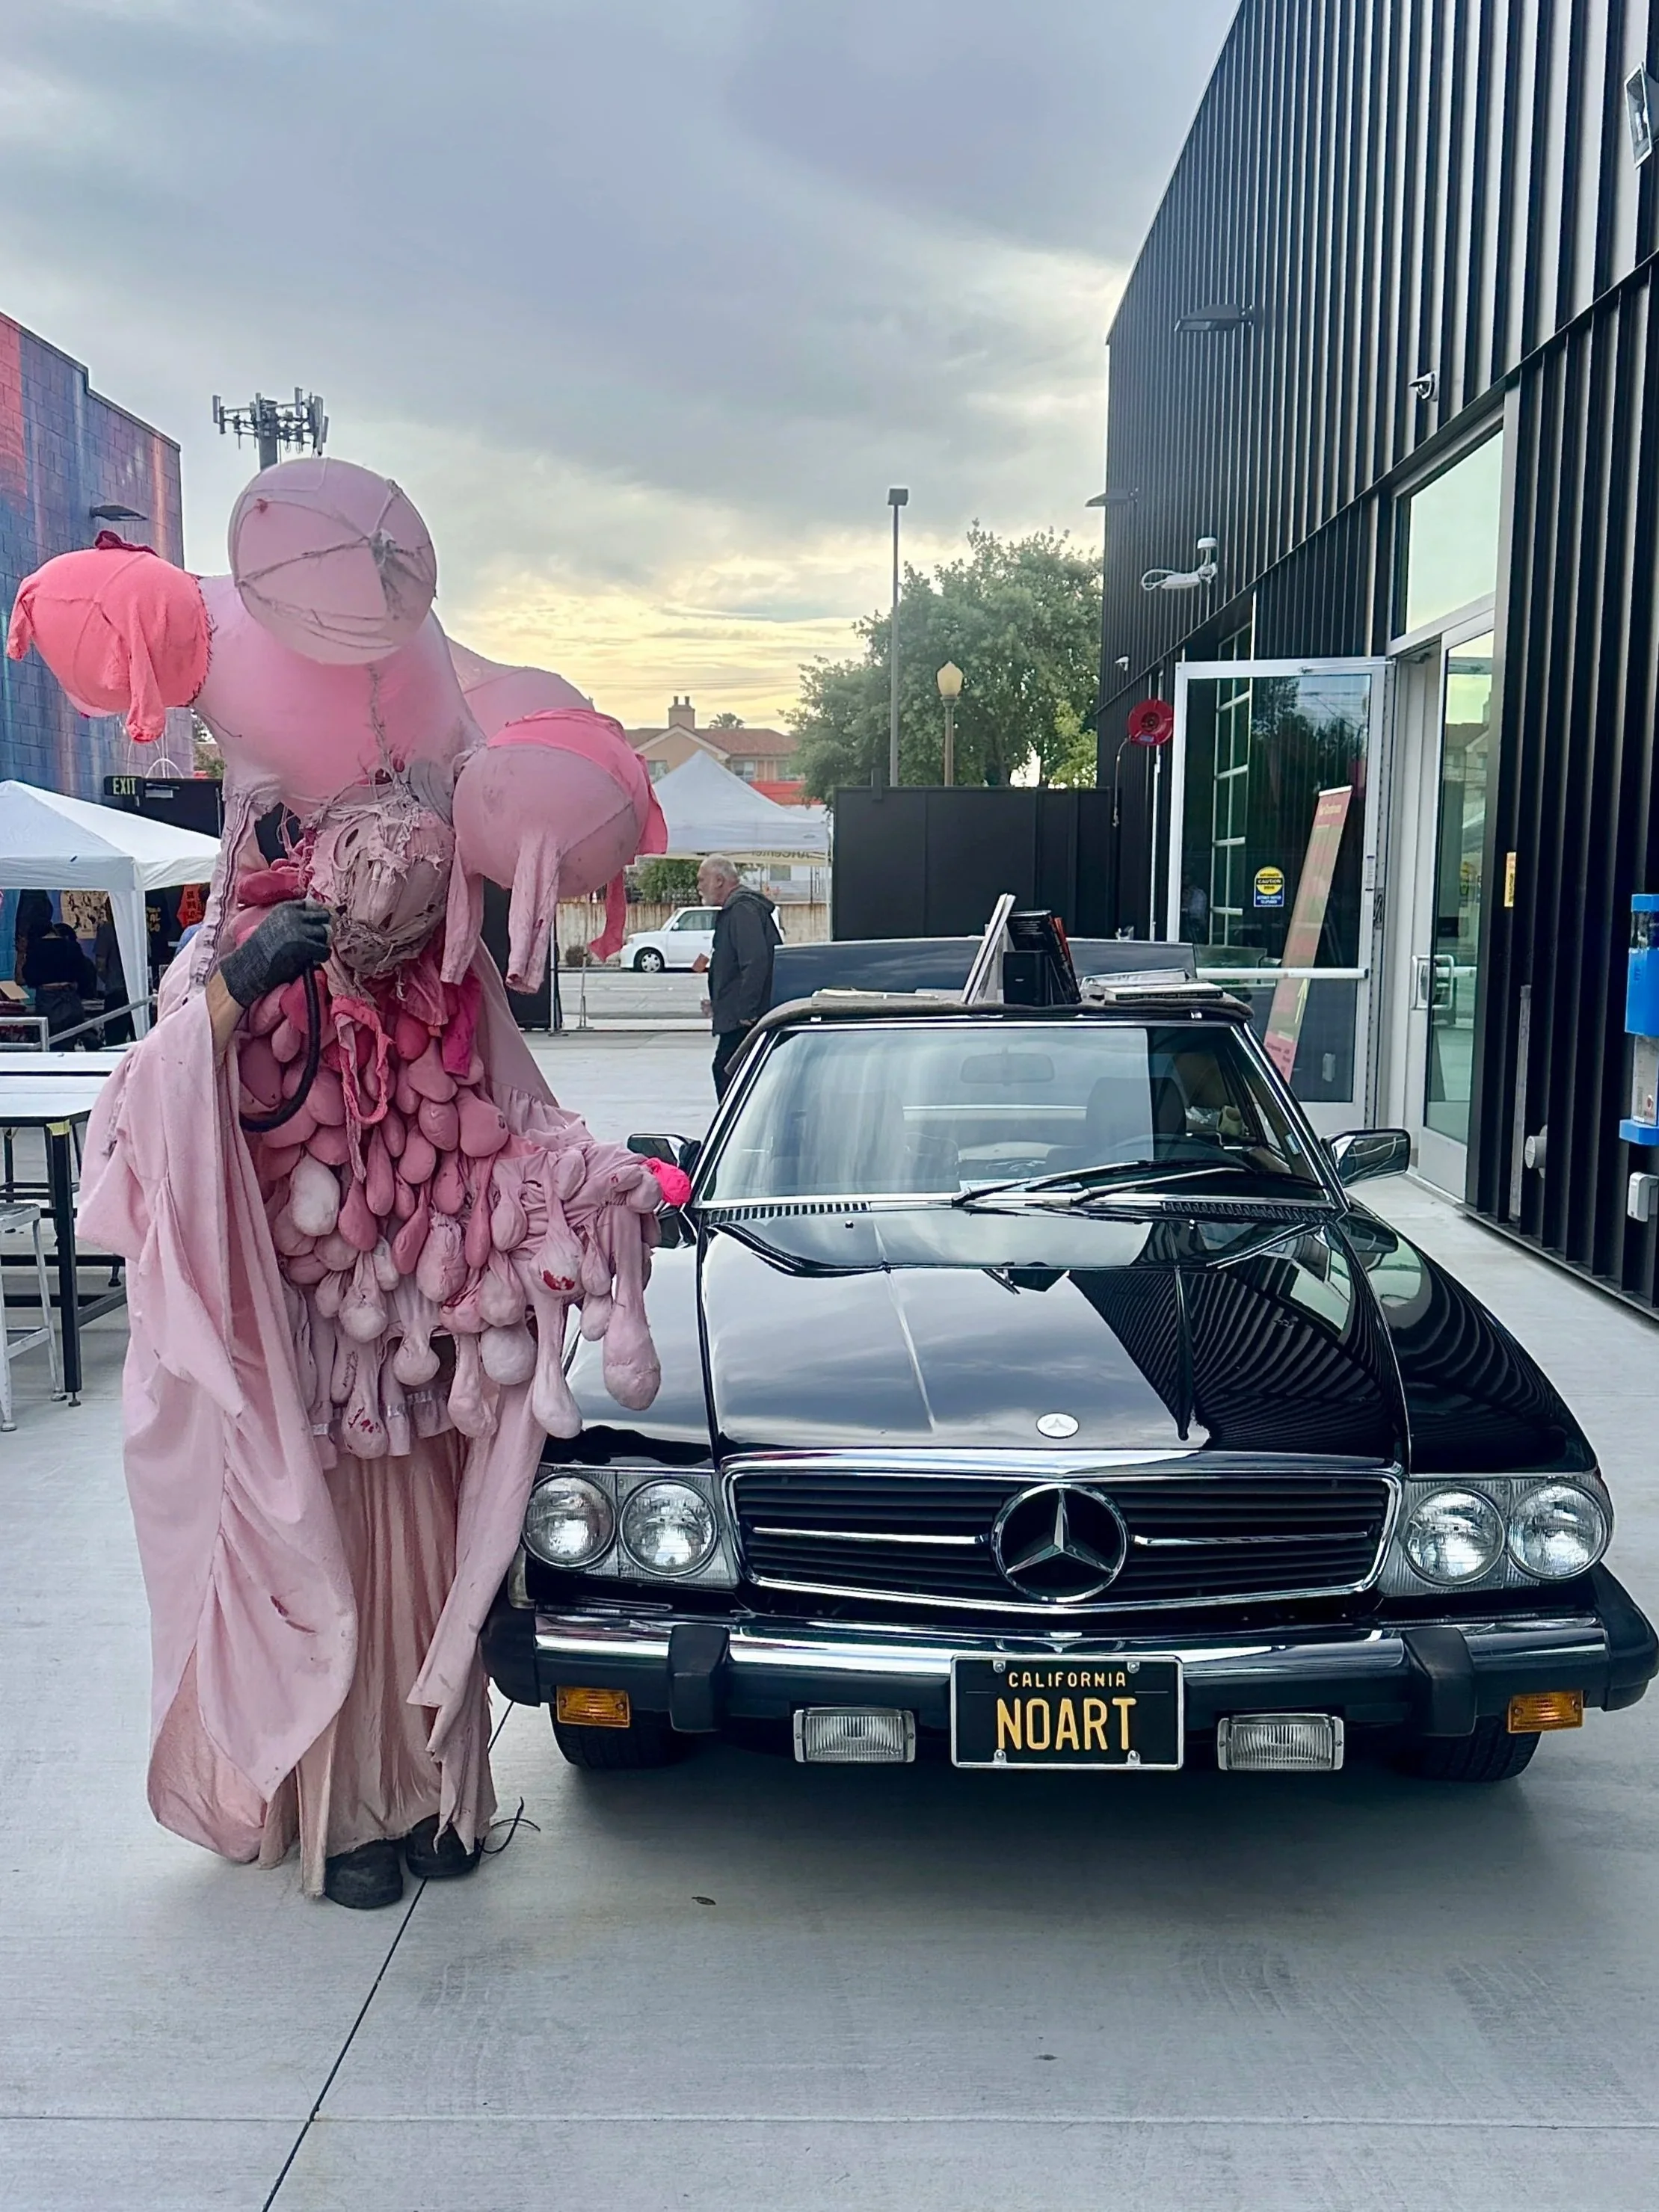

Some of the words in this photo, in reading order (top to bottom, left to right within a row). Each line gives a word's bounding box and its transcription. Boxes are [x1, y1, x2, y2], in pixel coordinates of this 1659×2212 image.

[113, 777, 136, 795] EXIT
[1009, 1672, 1126, 1688] CALIFORNIA
[997, 1698, 1136, 1750] NOART
